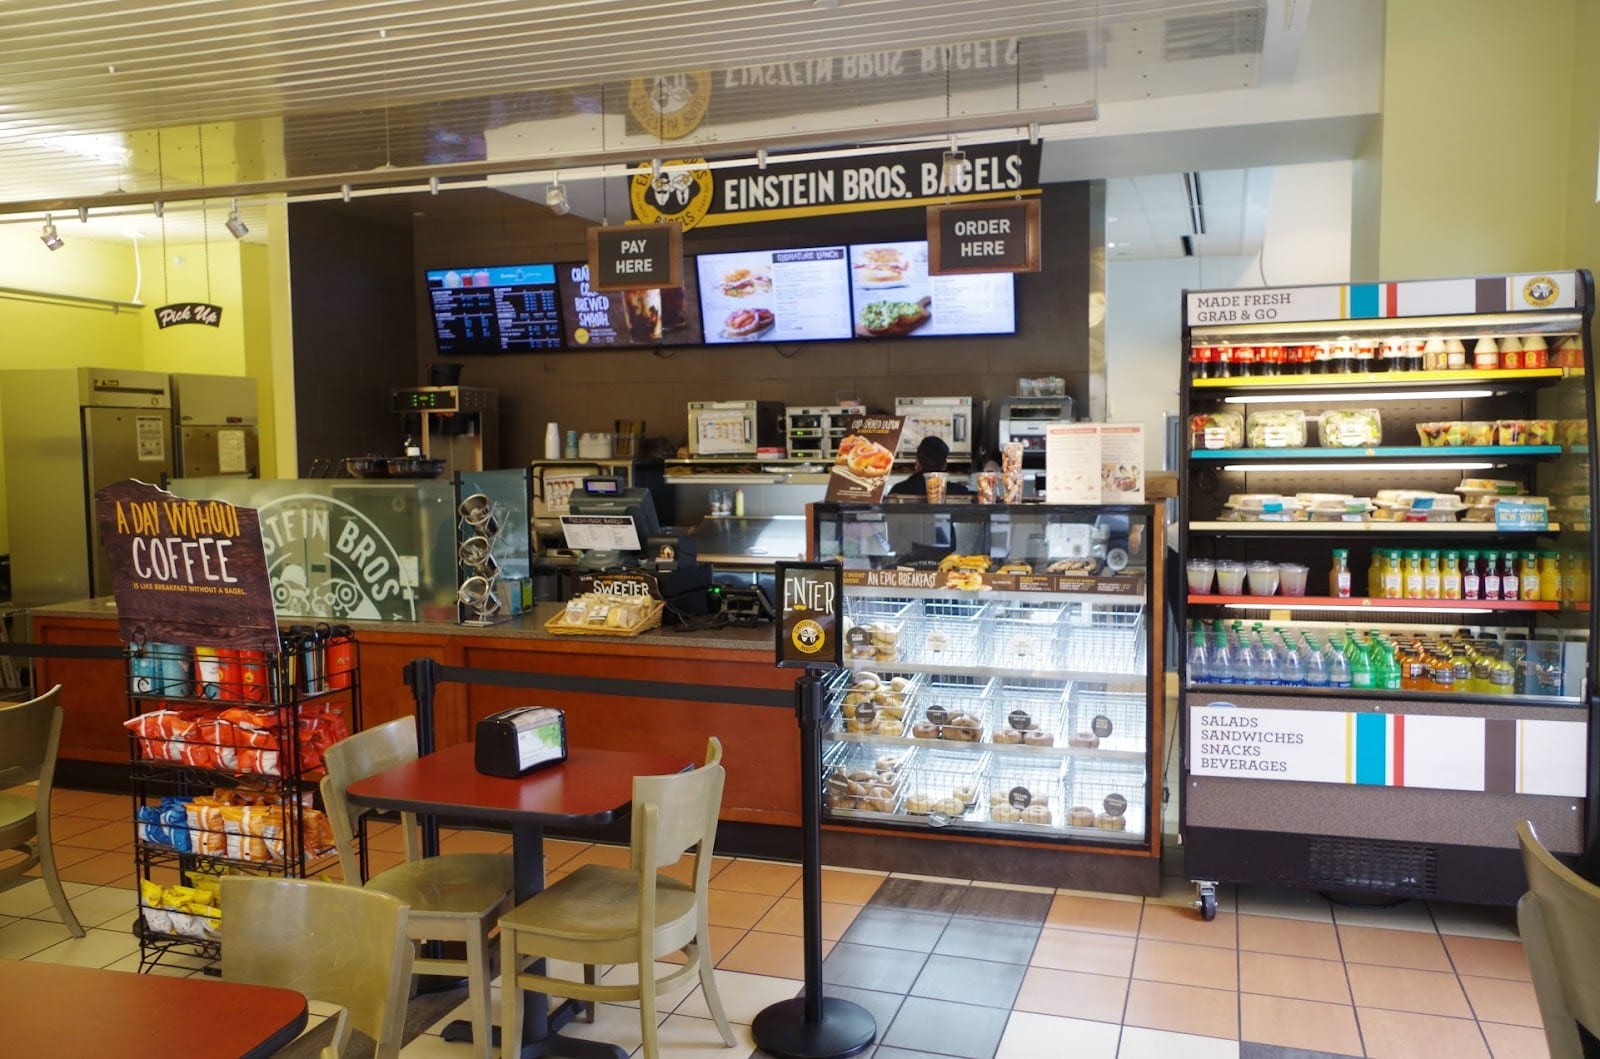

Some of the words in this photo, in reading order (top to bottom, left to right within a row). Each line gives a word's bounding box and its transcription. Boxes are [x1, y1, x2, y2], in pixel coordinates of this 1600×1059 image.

[724, 169, 836, 211] EINSTEIN
[842, 164, 913, 201] BROS.
[920, 154, 1023, 196] BAGELS
[954, 218, 1011, 236] ORDER
[620, 239, 648, 255] PAY
[960, 240, 1006, 257] HERE
[615, 258, 654, 274] HERE
[574, 296, 611, 312] BREWED
[1197, 296, 1240, 308] MADE
[1244, 293, 1291, 306] FRESH
[159, 305, 191, 327] Pick
[194, 305, 217, 325] Up
[1197, 310, 1237, 322] GRAB
[1240, 310, 1251, 320] &
[1254, 308, 1278, 320] GO
[116, 500, 130, 535] A
[130, 501, 160, 536] DAY
[132, 536, 239, 585] COFFEE
[336, 519, 400, 602] BROS
[868, 571, 879, 586] AN
[880, 571, 897, 587] EPIC
[898, 572, 938, 588] BREAKFAST
[133, 582, 140, 590] IS
[154, 584, 188, 592] BREAKFAST
[189, 585, 217, 594] WITHOUT
[592, 580, 650, 597] SWEETER
[783, 576, 835, 615] ENTER
[1200, 715, 1259, 728] SALADS
[1200, 729, 1304, 745] SANDWICHES
[1200, 743, 1261, 757] SNACKS
[1200, 757, 1288, 773] BEVERAGES
